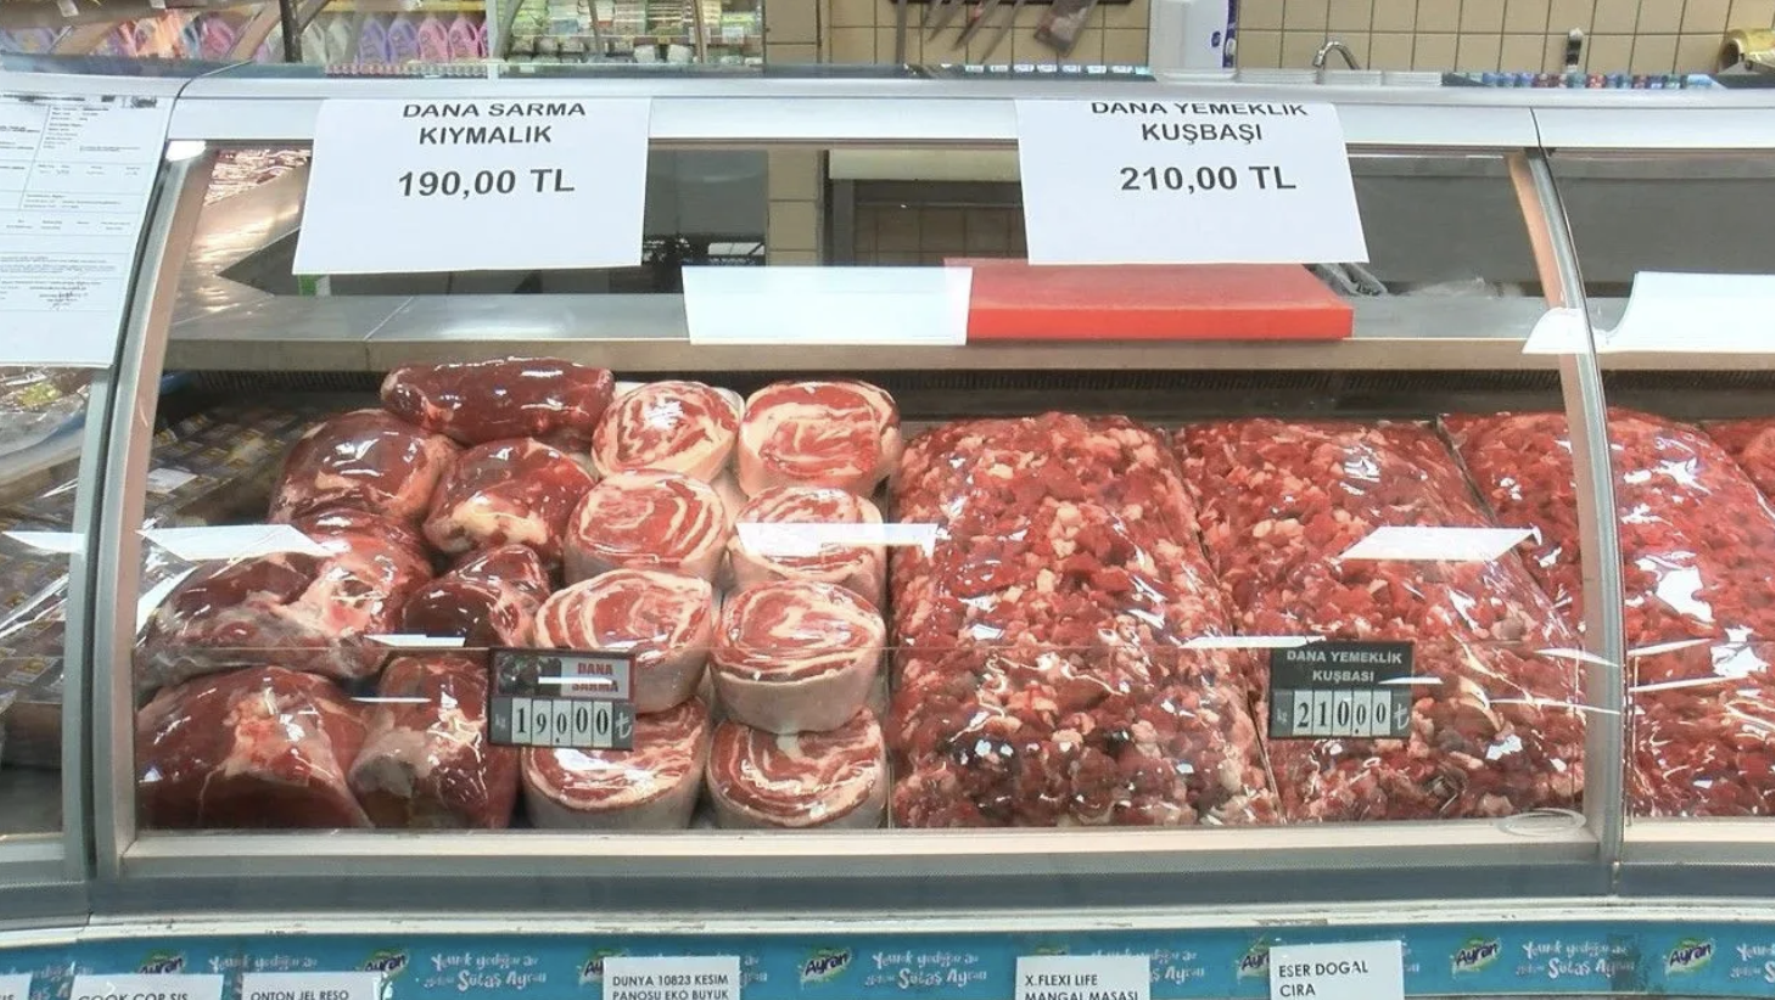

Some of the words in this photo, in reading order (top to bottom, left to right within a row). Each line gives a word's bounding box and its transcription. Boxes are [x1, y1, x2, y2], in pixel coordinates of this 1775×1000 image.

[403, 103, 480, 118] DANA
[488, 102, 586, 117] SARMA
[1091, 102, 1168, 115] DANA
[419, 125, 552, 145] KIYMALIK
[1142, 123, 1263, 145] KUŞBAŞI
[399, 169, 516, 200] 190,00
[530, 168, 575, 193] TL
[1120, 166, 1238, 195] 210,00
[1249, 165, 1297, 190] TL
[1287, 649, 1327, 663] DANA
[577, 662, 613, 676] DANA
[1456, 942, 1498, 966] Ayran
[1669, 943, 1711, 966] Ayran
[805, 952, 849, 976] Ayran
[1279, 964, 1311, 978] ESER
[1315, 960, 1369, 976] DOGAL
[612, 975, 654, 987] DUNYA
[658, 974, 691, 987] 10823
[694, 974, 729, 986] KESIM
[1074, 974, 1098, 986] LIFE
[299, 990, 316, 1000] JEL
[612, 990, 662, 1000] PANOSU
[664, 990, 689, 1000] EKO
[692, 989, 729, 1000] BUYUK
[1279, 983, 1316, 998] CIRA
